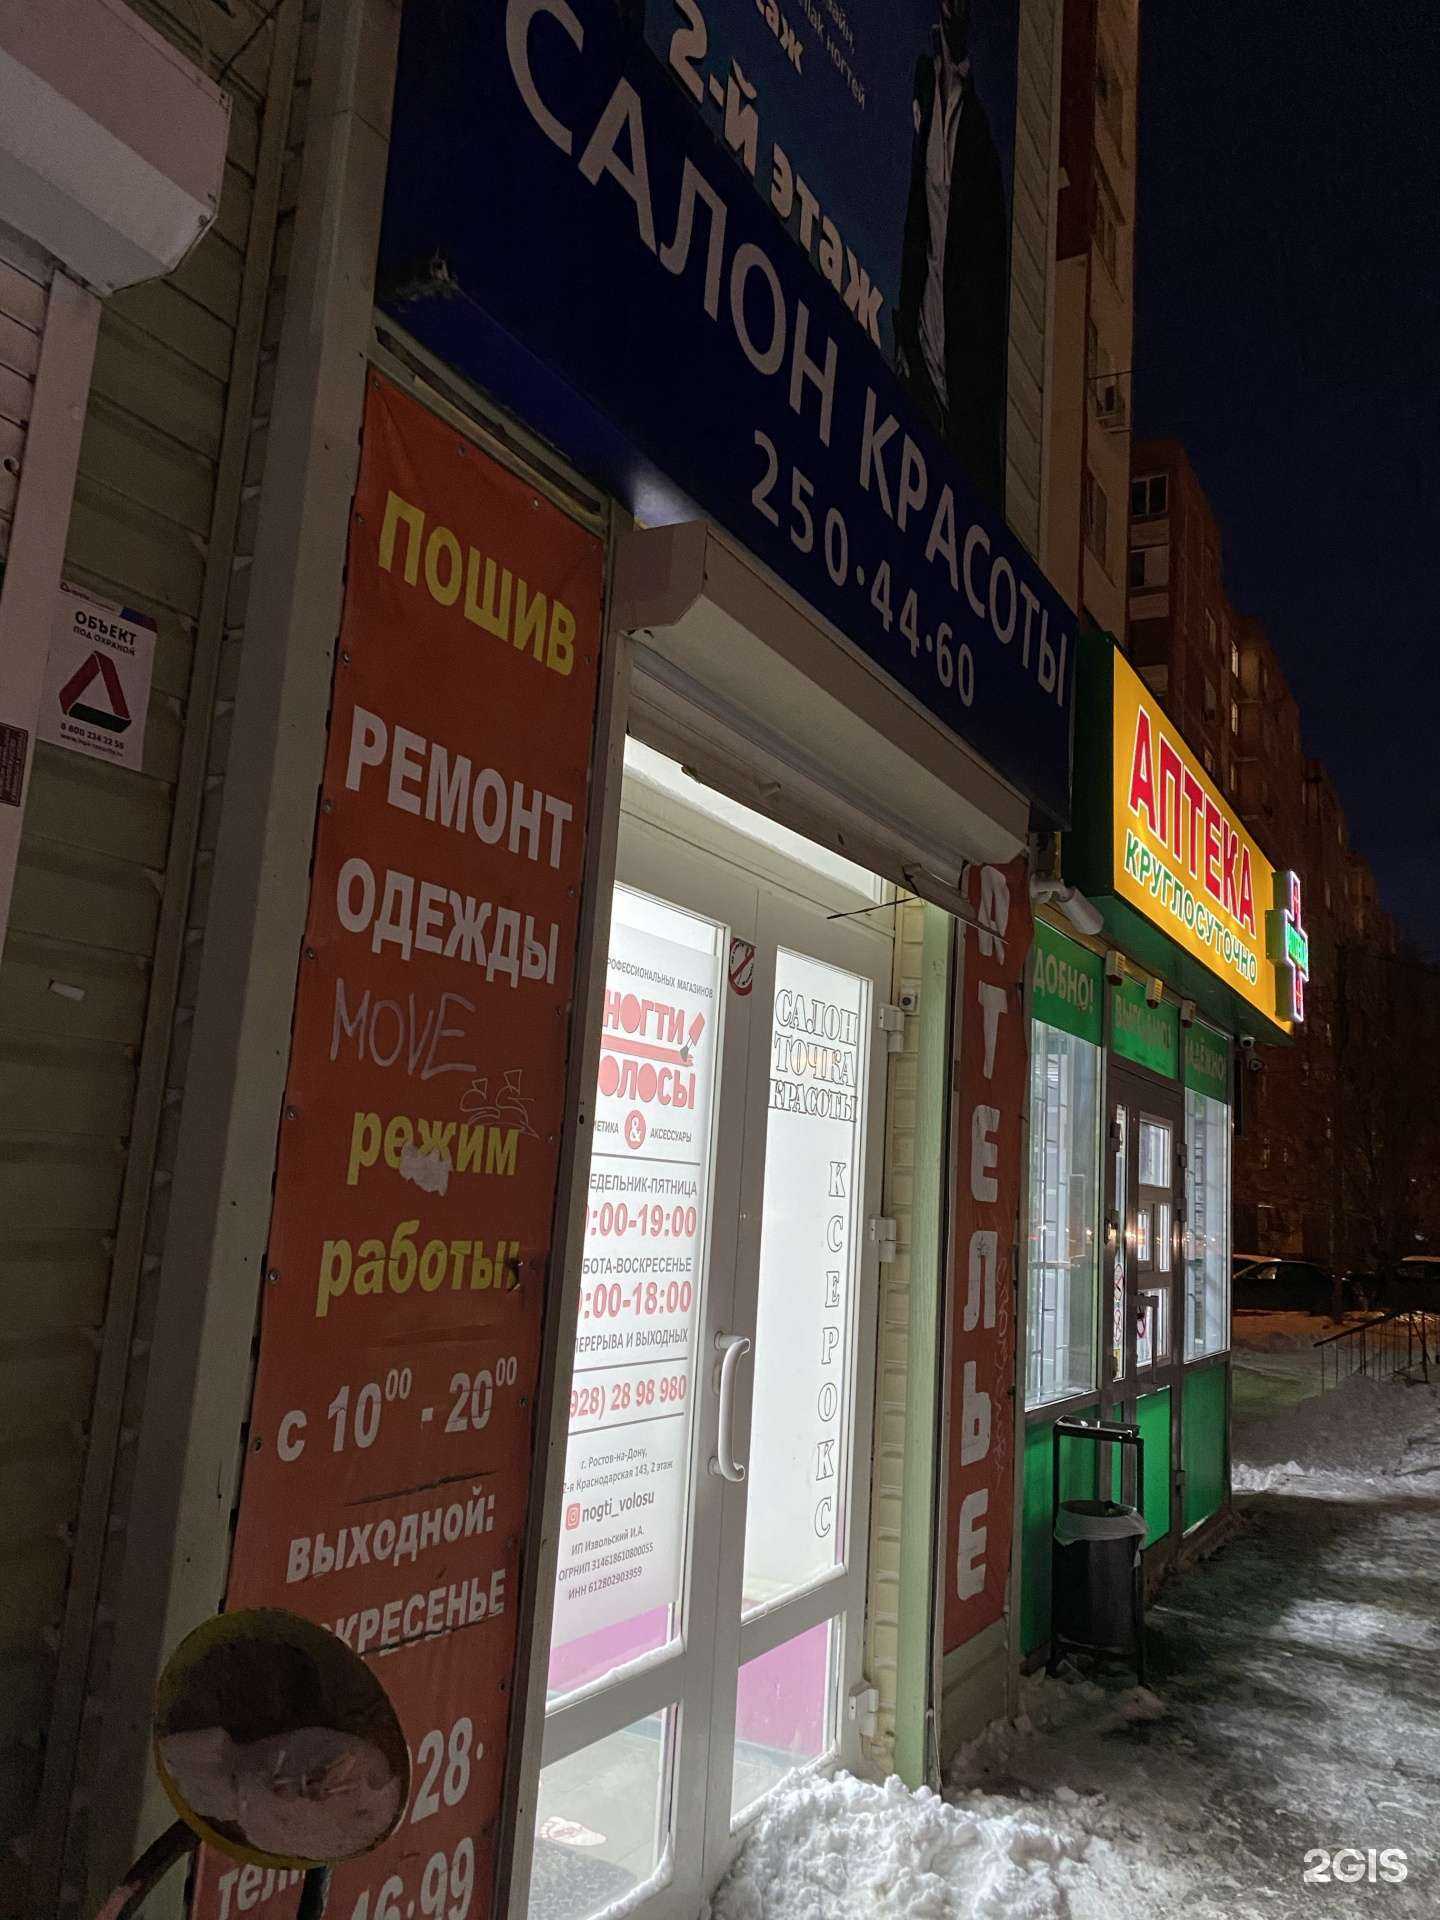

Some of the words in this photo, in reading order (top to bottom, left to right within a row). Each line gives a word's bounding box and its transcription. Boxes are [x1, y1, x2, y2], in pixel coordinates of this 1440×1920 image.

[669, 0, 759, 178] 2-й
[770, 142, 885, 351] этаж
[505, 0, 838, 447] САЛОН
[859, 386, 1068, 706] КРАСОТЫ
[378, 489, 577, 676] ПОШИВ
[73, 625, 92, 640] ПОД
[75, 611, 136, 646] ОБЪЕКТ
[345, 704, 573, 870] РЕМОНТ
[1128, 704, 1258, 940] АПТЕКА
[336, 857, 559, 988] ОДЕЖДЫ
[1124, 829, 1258, 986] КРУГЛОСУТОЧНО
[329, 977, 477, 1081] MOVE
[603, 989, 685, 1044] НОГТИ
[774, 988, 859, 1046] САЛОН
[774, 1033, 857, 1088] ТОЧКА
[767, 1078, 859, 1123] КРАСОТЫ
[346, 1111, 520, 1186] режим
[593, 1119, 619, 1136] ЕТИКА
[650, 1127, 693, 1143] АКСЕССУАРЫ
[586, 1202, 697, 1237] :00-19:00
[576, 1280, 692, 1319] :00-18:00
[626, 1335, 634, 1348] И
[635, 1327, 689, 1348] ВЫХОДНЫХ
[610, 1382, 632, 1411] 28
[636, 1379, 655, 1408] 98
[659, 1374, 688, 1404] 980
[576, 1469, 634, 1494] Краснодарская
[651, 1461, 656, 1472] 2
[657, 1460, 674, 1472] этаж
[582, 1490, 655, 1525] nogti_volosu
[571, 1542, 584, 1556] ИП
[585, 1527, 629, 1553] Извольский
[558, 1562, 591, 1582] ОГРНИП
[568, 1583, 587, 1601] ИНН
[321, 1568, 506, 1657] КРЕСЕНЬЕ
